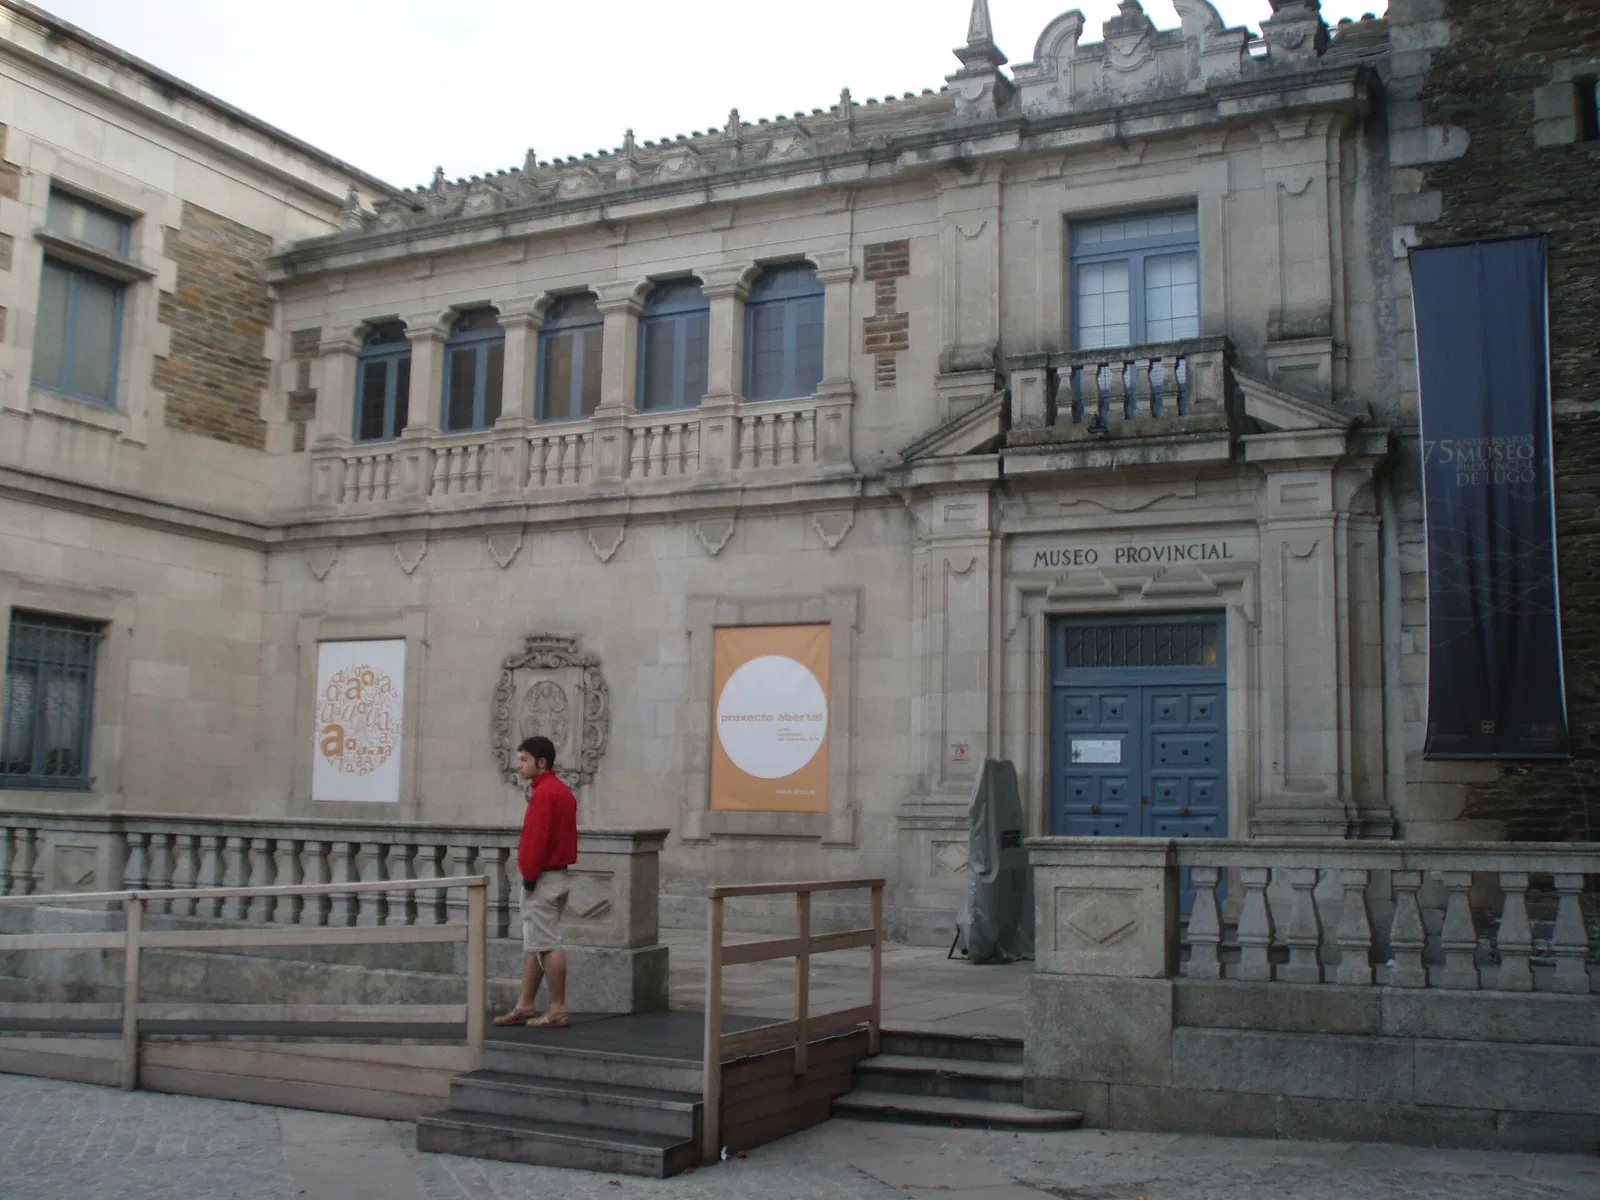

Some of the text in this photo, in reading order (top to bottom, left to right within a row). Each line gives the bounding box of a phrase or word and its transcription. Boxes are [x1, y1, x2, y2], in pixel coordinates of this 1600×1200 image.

[1424, 439, 1453, 464] 75
[1456, 443, 1535, 462] MUSEO
[1456, 469, 1536, 486] DE LUGO
[1033, 542, 1233, 568] MUSEO PROVINCIAL
[720, 713, 774, 724] proxecto
[320, 724, 344, 757] a
